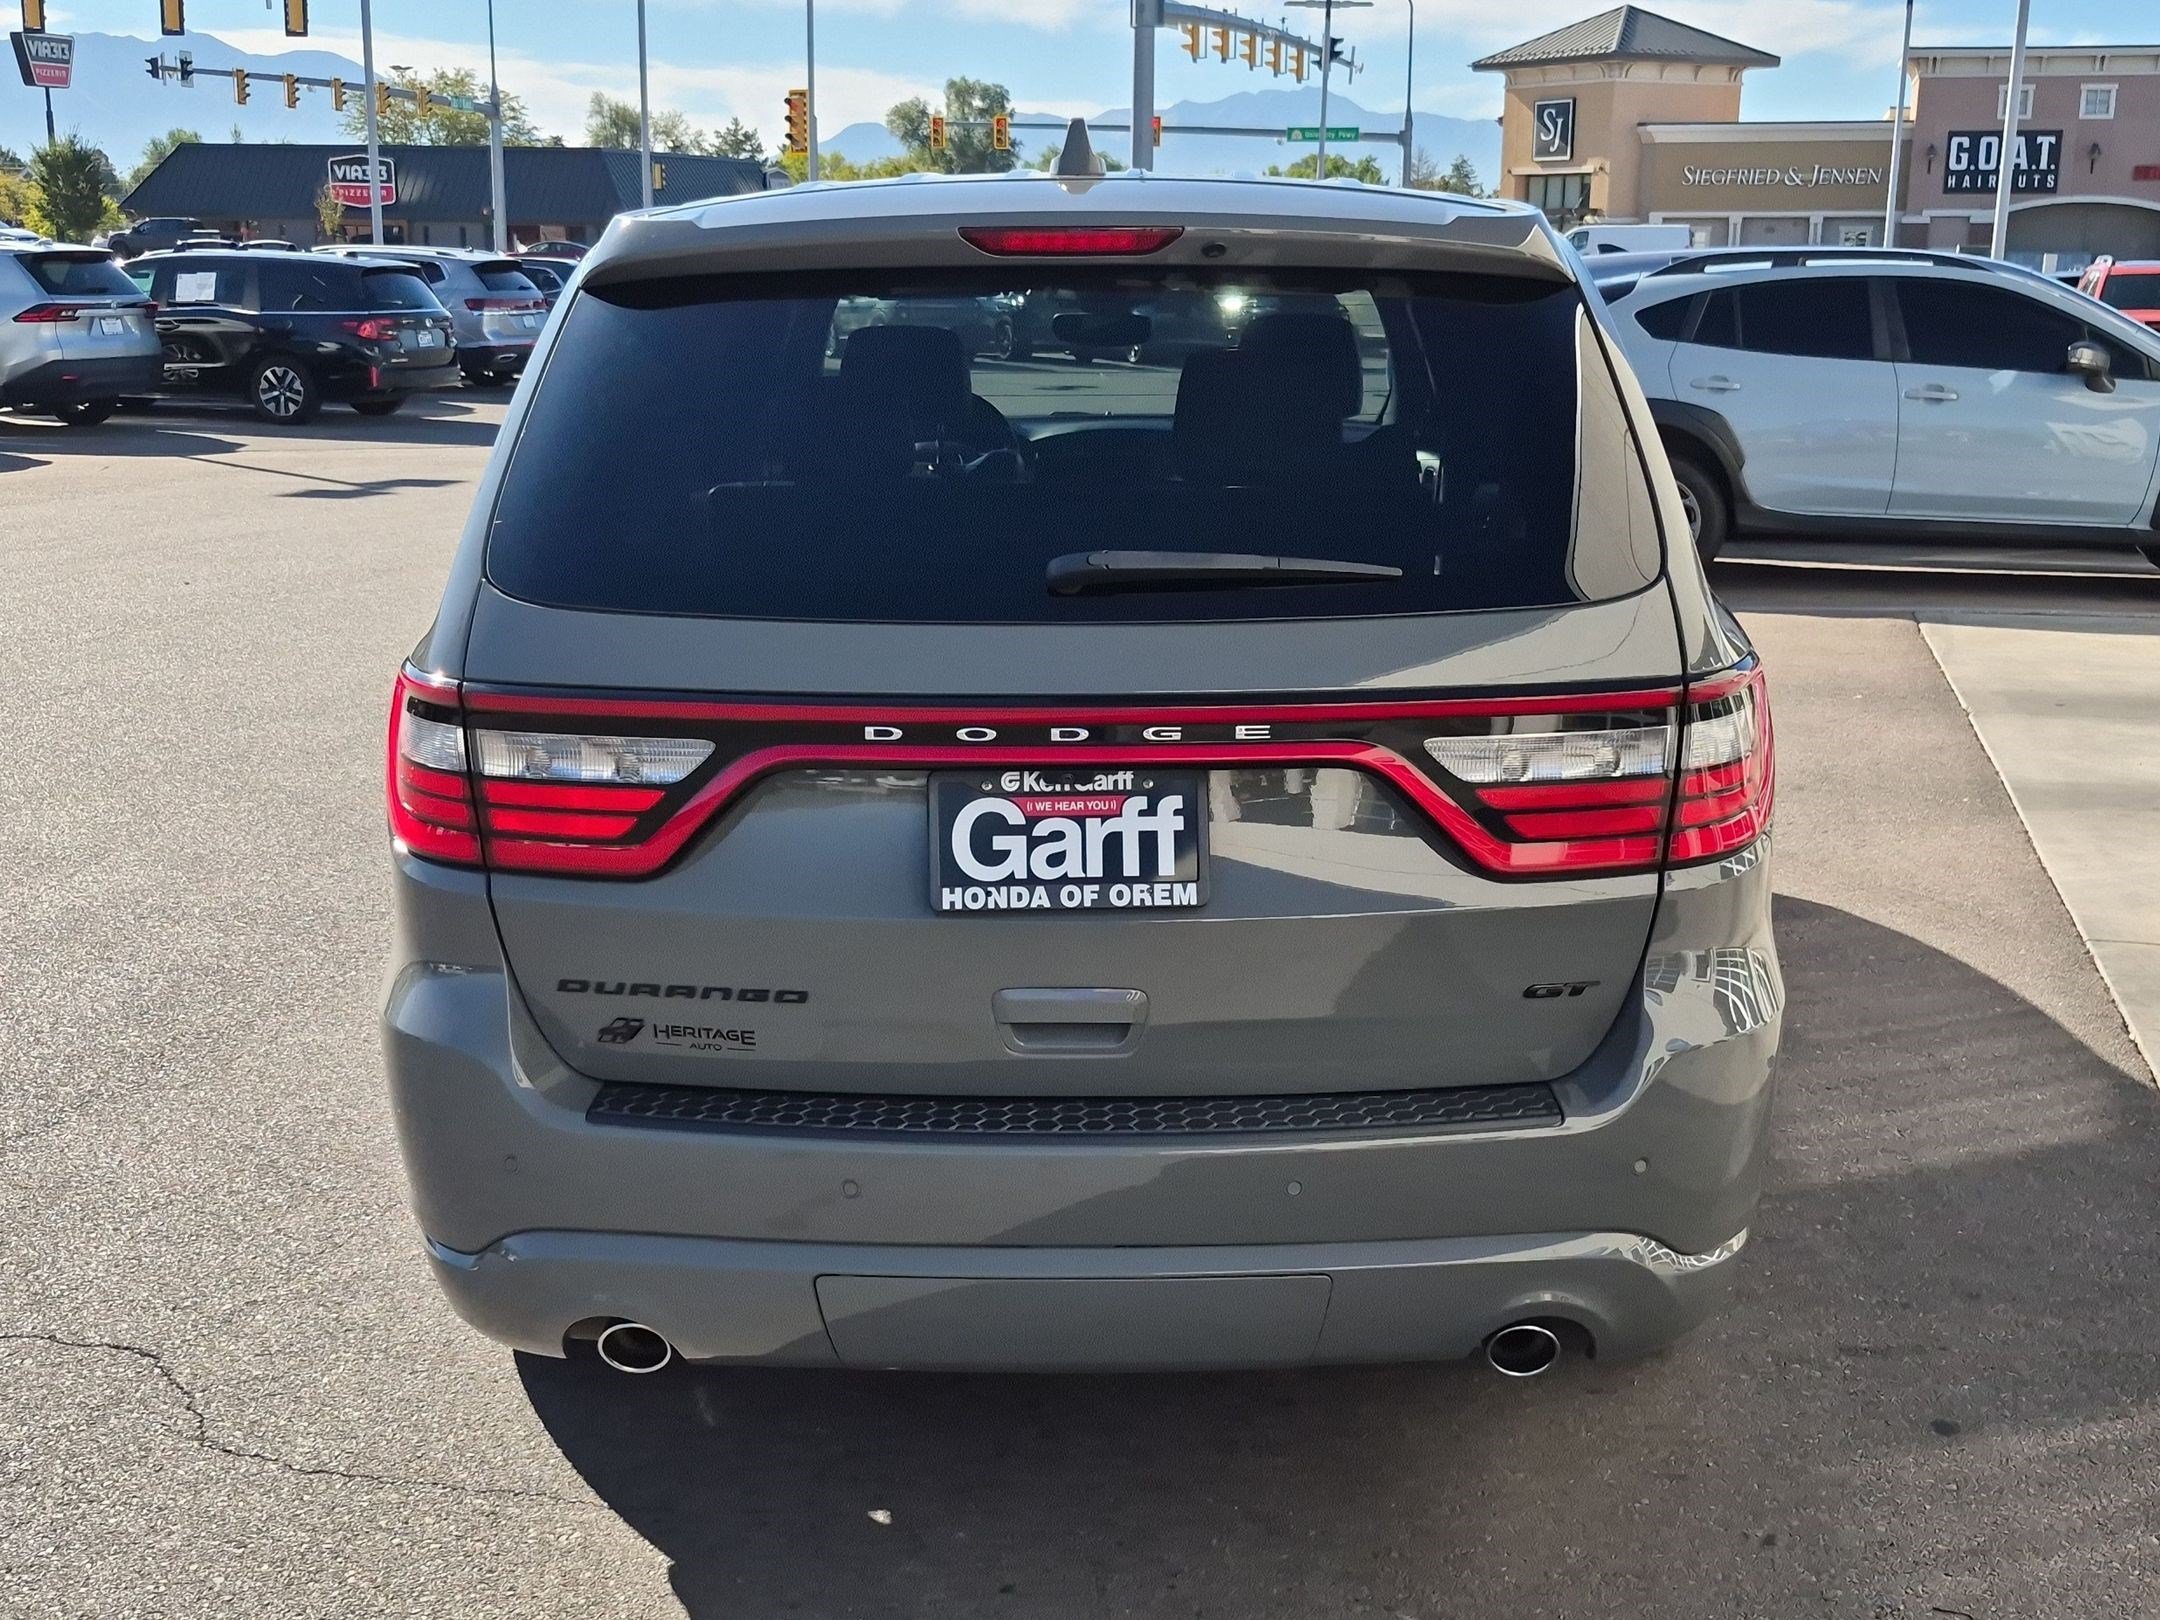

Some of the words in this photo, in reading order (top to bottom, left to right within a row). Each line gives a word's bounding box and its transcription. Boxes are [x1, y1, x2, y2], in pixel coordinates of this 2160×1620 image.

[1540, 108, 1564, 153] SJ
[1948, 135, 2057, 171] G.OA.T.
[333, 164, 388, 181] VIA33
[1682, 165, 1780, 186] SIEGFRIED
[1784, 166, 1804, 186] &
[1808, 165, 1882, 188] JENSEN
[1947, 174, 2056, 189] HAIRUTS
[339, 188, 387, 197] PIZZEA
[864, 725, 1271, 742] DODGE
[1035, 801, 1053, 811] WE
[1055, 801, 1084, 810] HEAR
[1086, 800, 1110, 810] YOU
[952, 795, 1184, 882] Garff
[942, 886, 1051, 910] HONDA
[1059, 886, 1101, 908] OF
[1109, 882, 1198, 907] OREM
[556, 979, 809, 1004] DURANGO
[1522, 980, 1600, 998] GT
[653, 1023, 757, 1046] HERITAGE
[689, 1042, 722, 1051] AUTO
